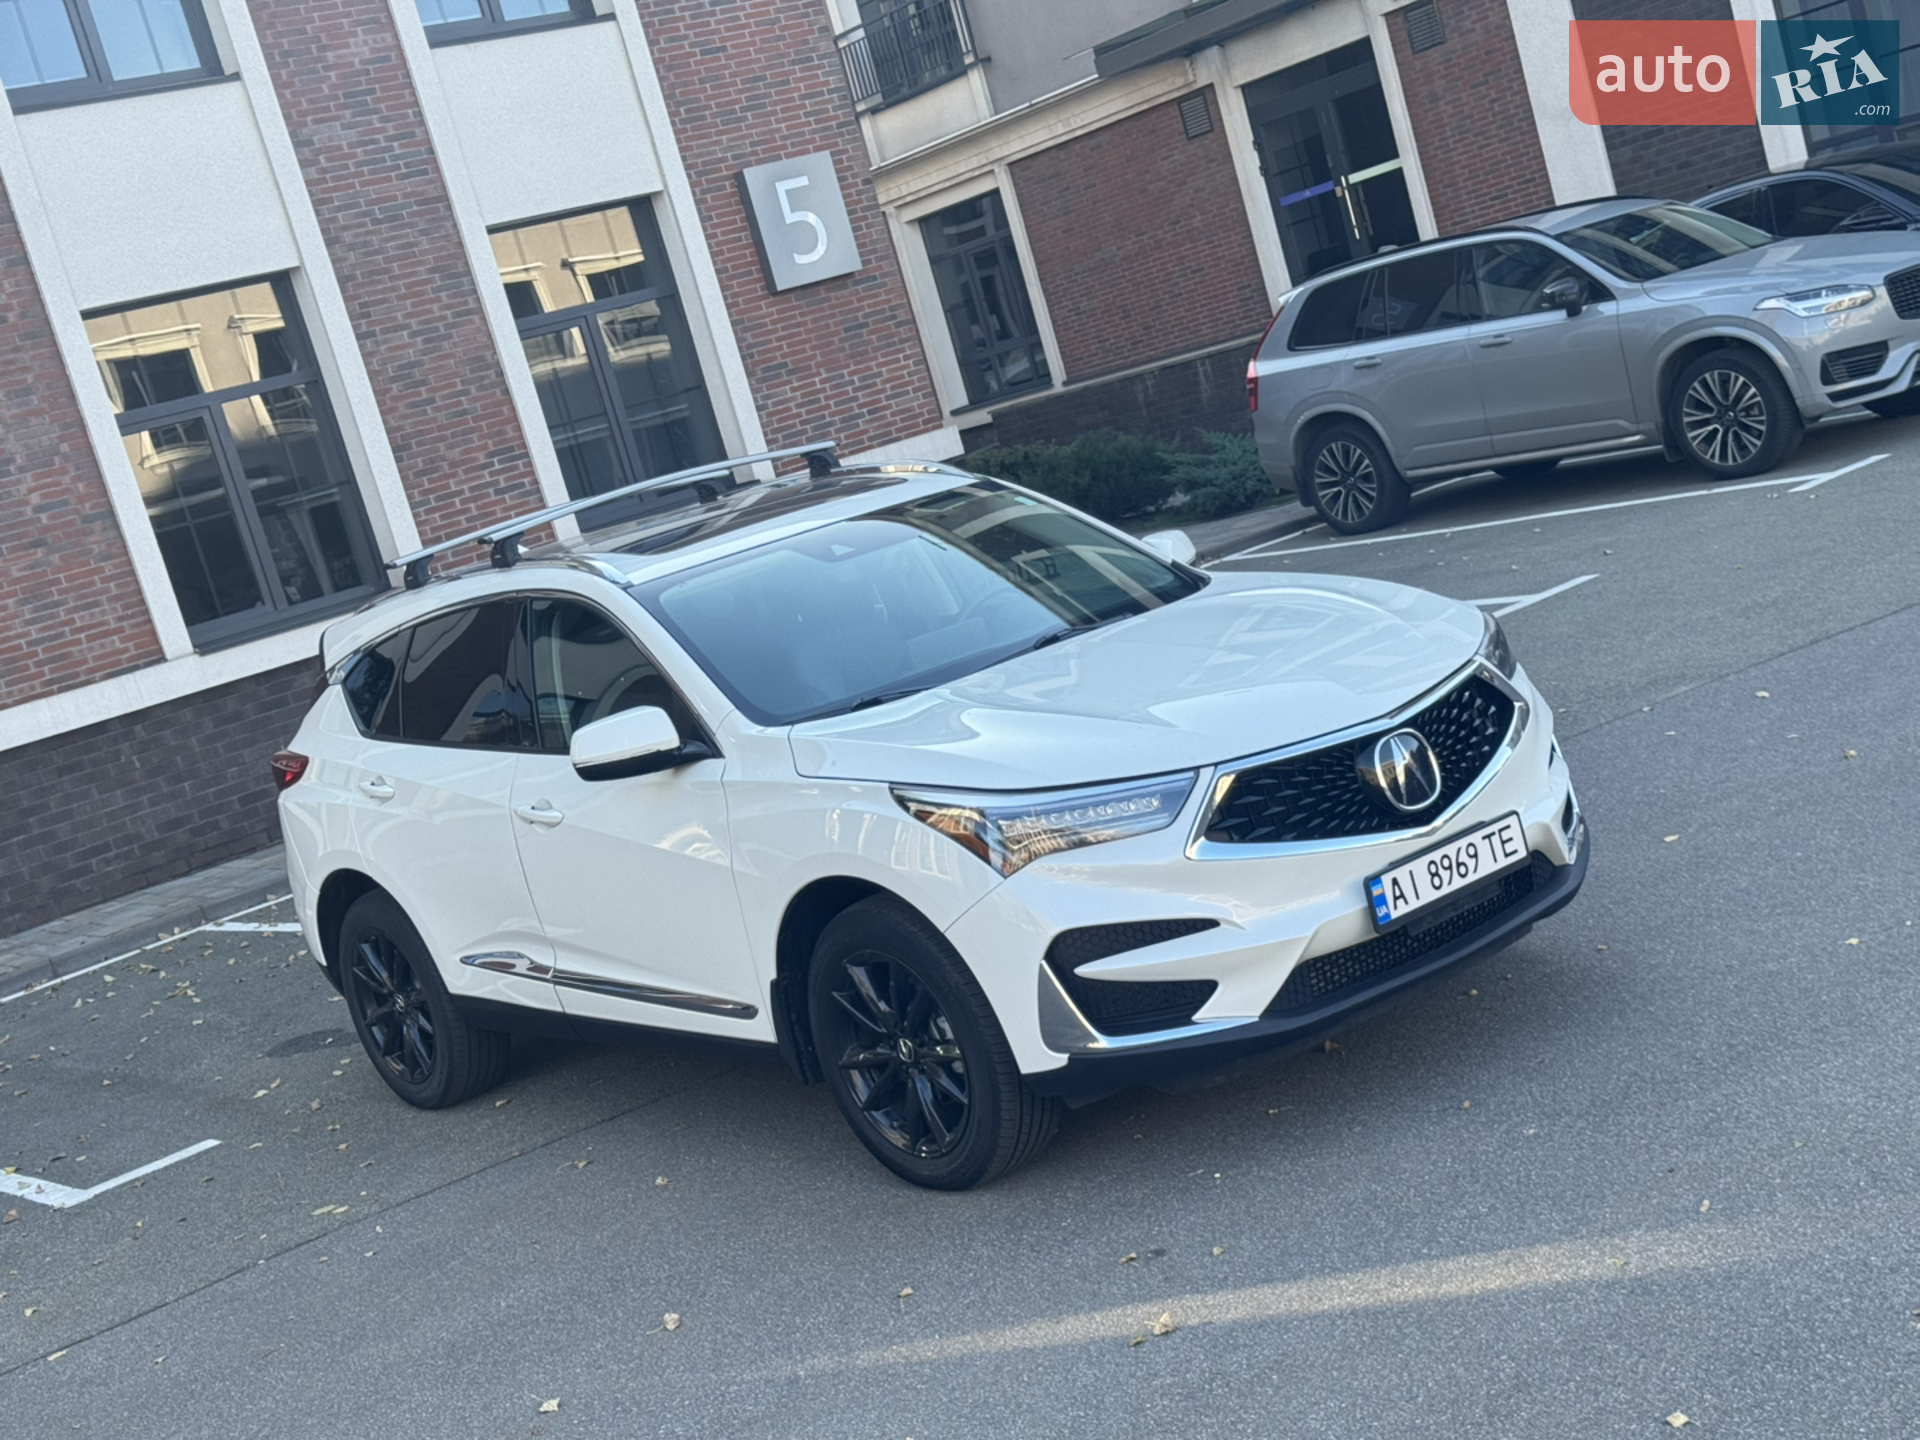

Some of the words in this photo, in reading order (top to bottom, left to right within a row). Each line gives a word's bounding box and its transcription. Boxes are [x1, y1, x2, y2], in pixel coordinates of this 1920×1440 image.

[775, 175, 828, 265] 5
[1391, 870, 1420, 910] AI
[1427, 842, 1479, 890] 8969
[1482, 824, 1518, 863] TE
[1376, 904, 1390, 917] UA
